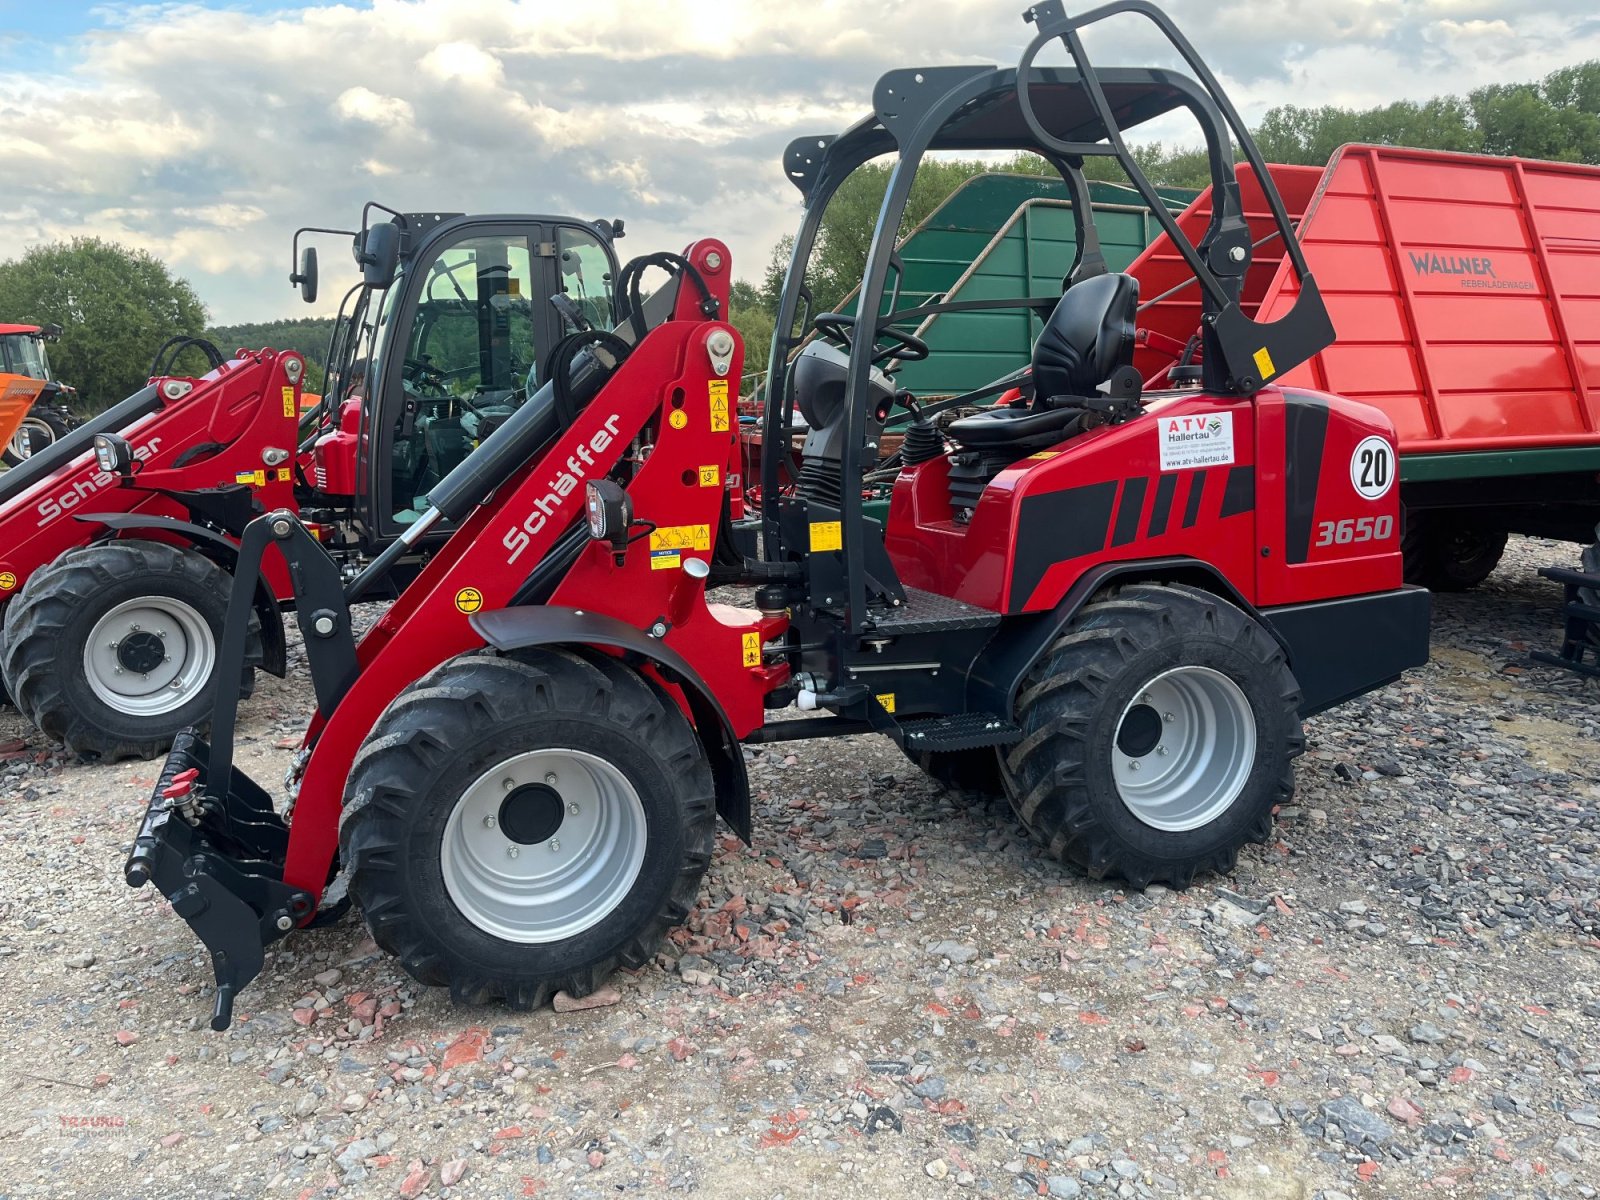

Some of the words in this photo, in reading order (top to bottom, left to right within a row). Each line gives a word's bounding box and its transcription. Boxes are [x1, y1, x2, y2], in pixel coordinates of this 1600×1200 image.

[1408, 251, 1496, 278] WALLNER
[1461, 279, 1535, 290] REBENLADEWAGEN
[1168, 432, 1210, 442] Hallertau
[1166, 454, 1229, 468] www.atv-hallertau.de
[1360, 448, 1387, 488] 20
[502, 413, 620, 565] Schäffer
[1315, 515, 1393, 547] 3650
